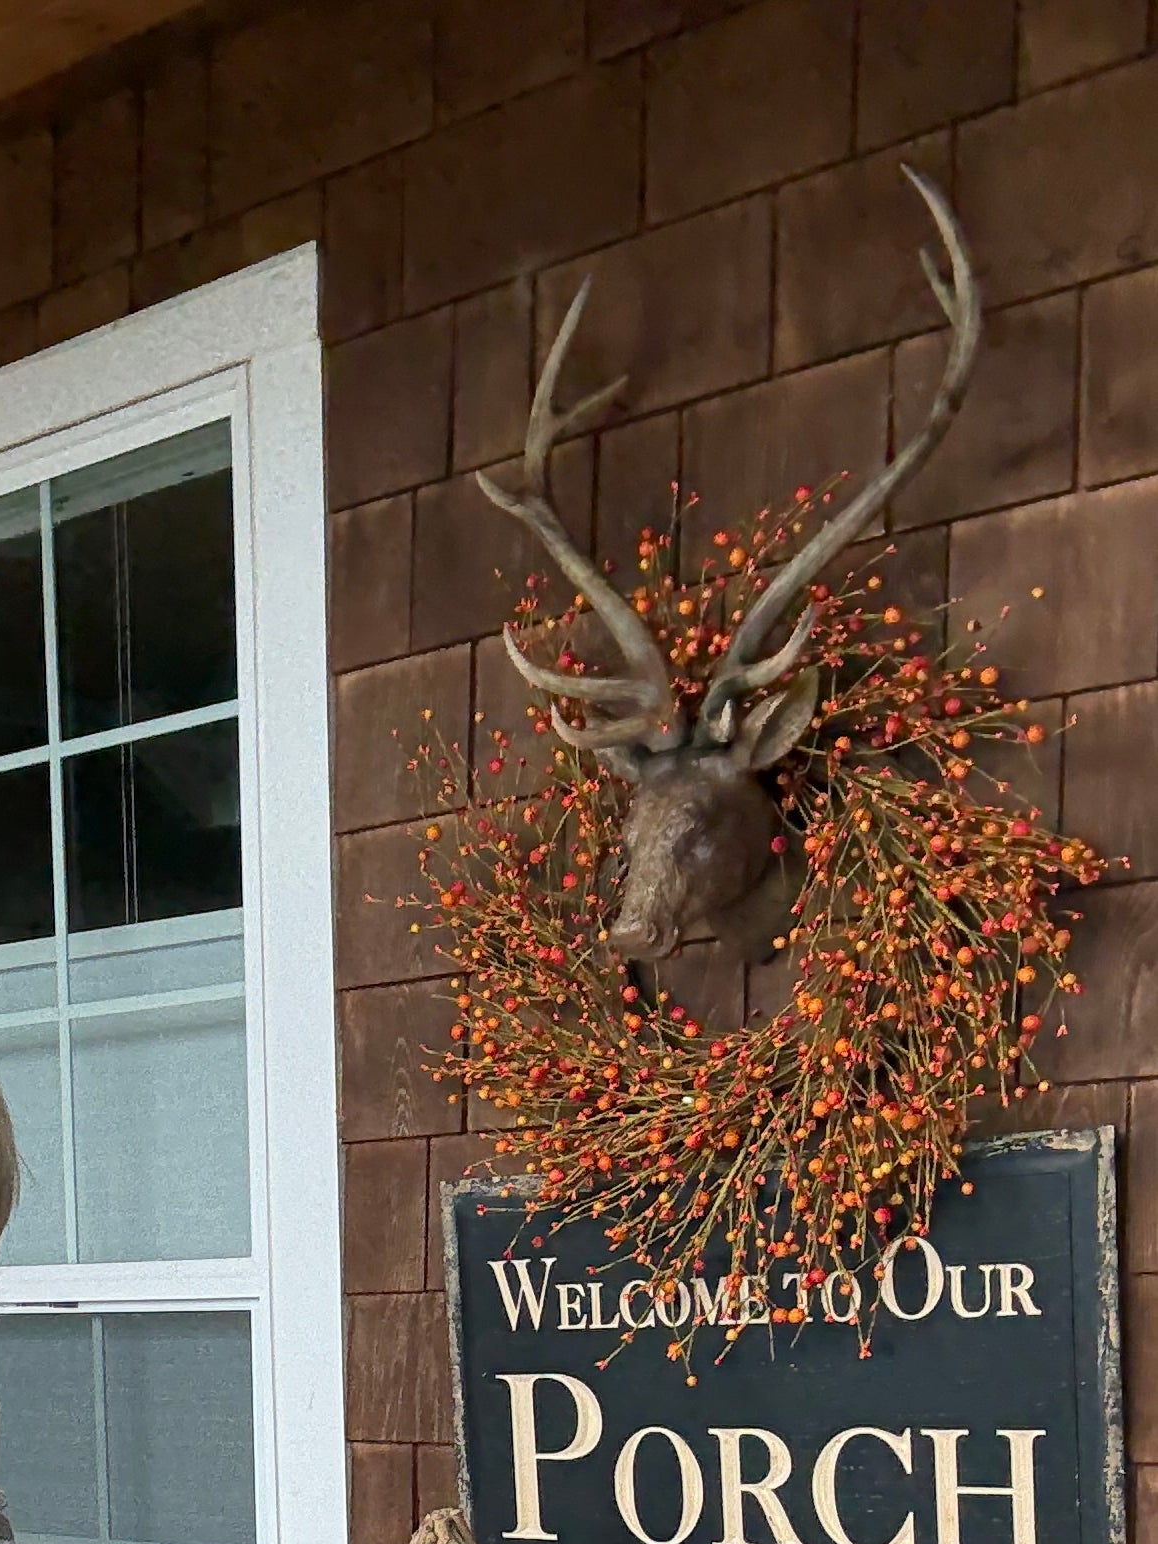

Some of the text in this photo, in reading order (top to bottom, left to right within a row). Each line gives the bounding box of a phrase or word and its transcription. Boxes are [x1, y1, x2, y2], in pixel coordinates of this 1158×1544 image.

[487, 1235, 1042, 1332] WELCOME TO OUR
